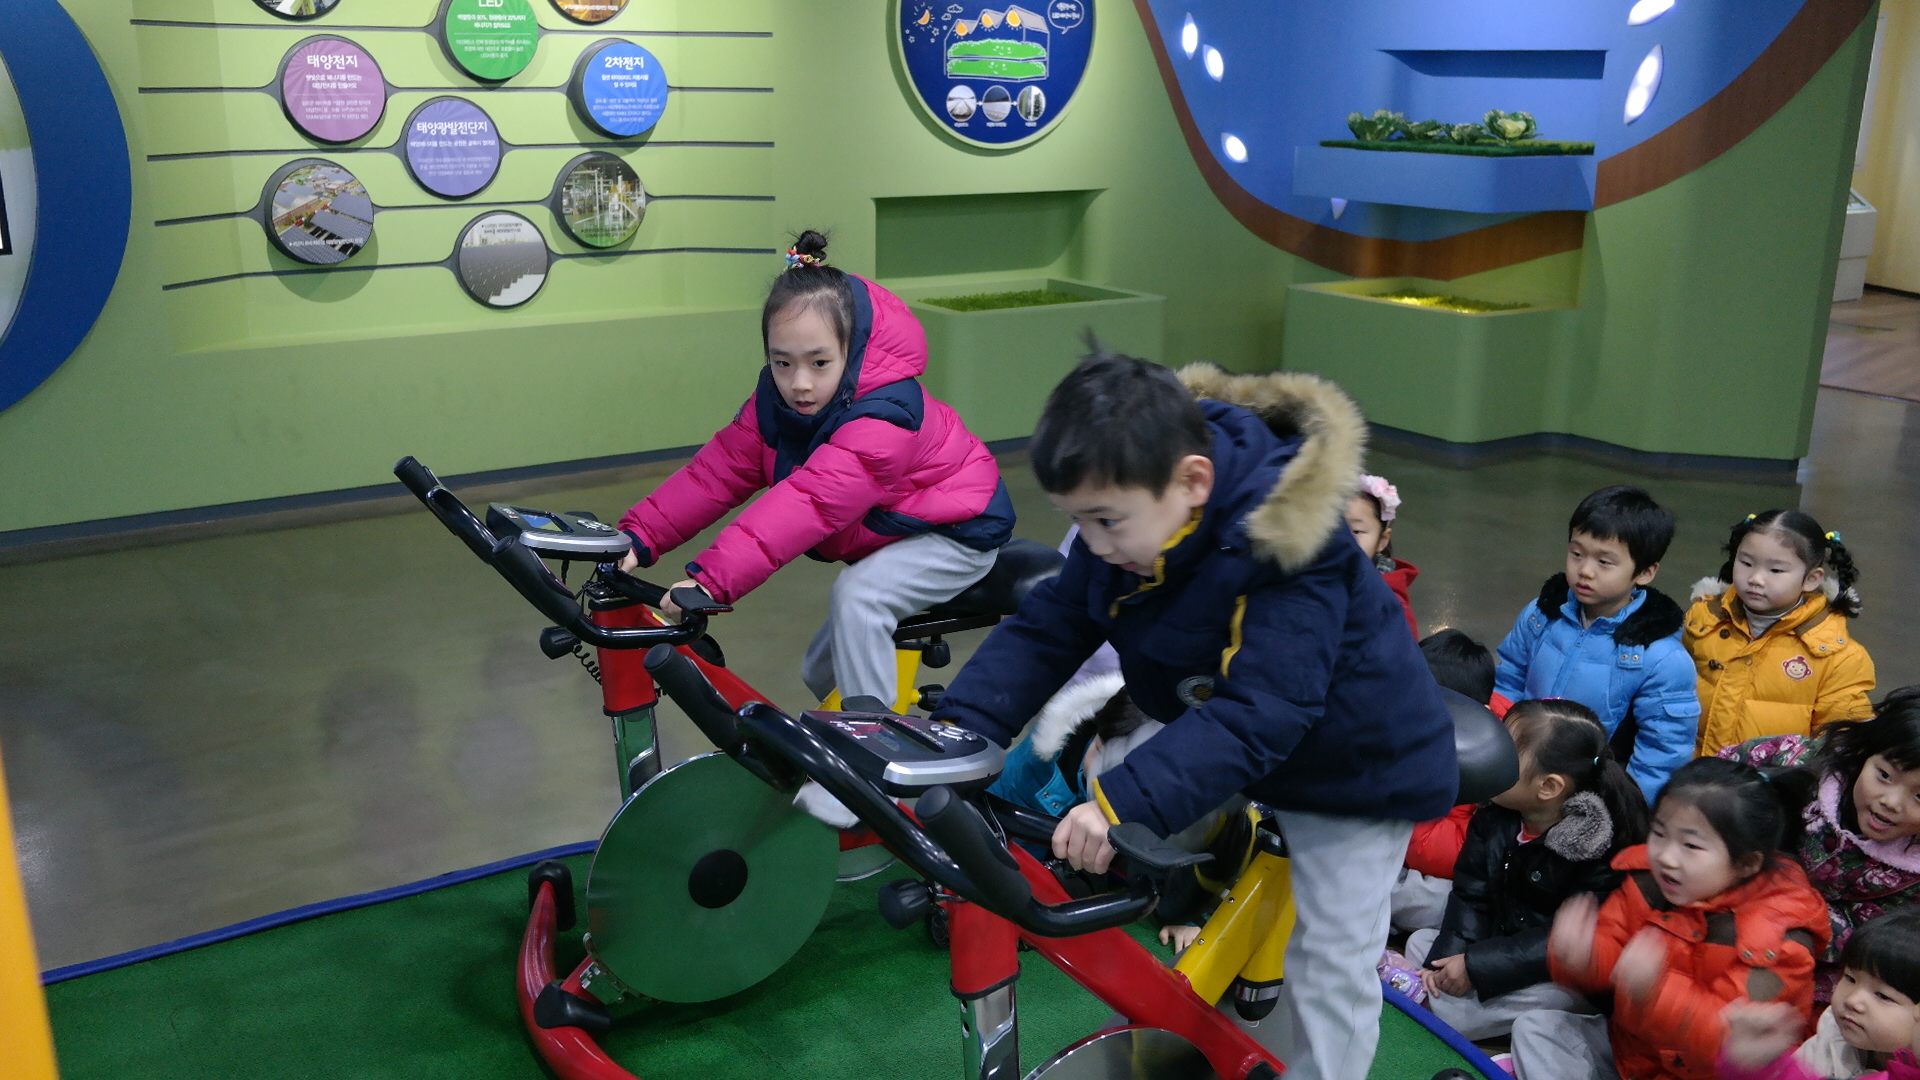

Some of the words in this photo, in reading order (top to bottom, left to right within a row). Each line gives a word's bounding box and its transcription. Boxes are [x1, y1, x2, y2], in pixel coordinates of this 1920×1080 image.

[306, 54, 358, 70] 태양전지
[604, 56, 644, 70] 2차전지
[416, 121, 488, 135] 태양광발전단지
